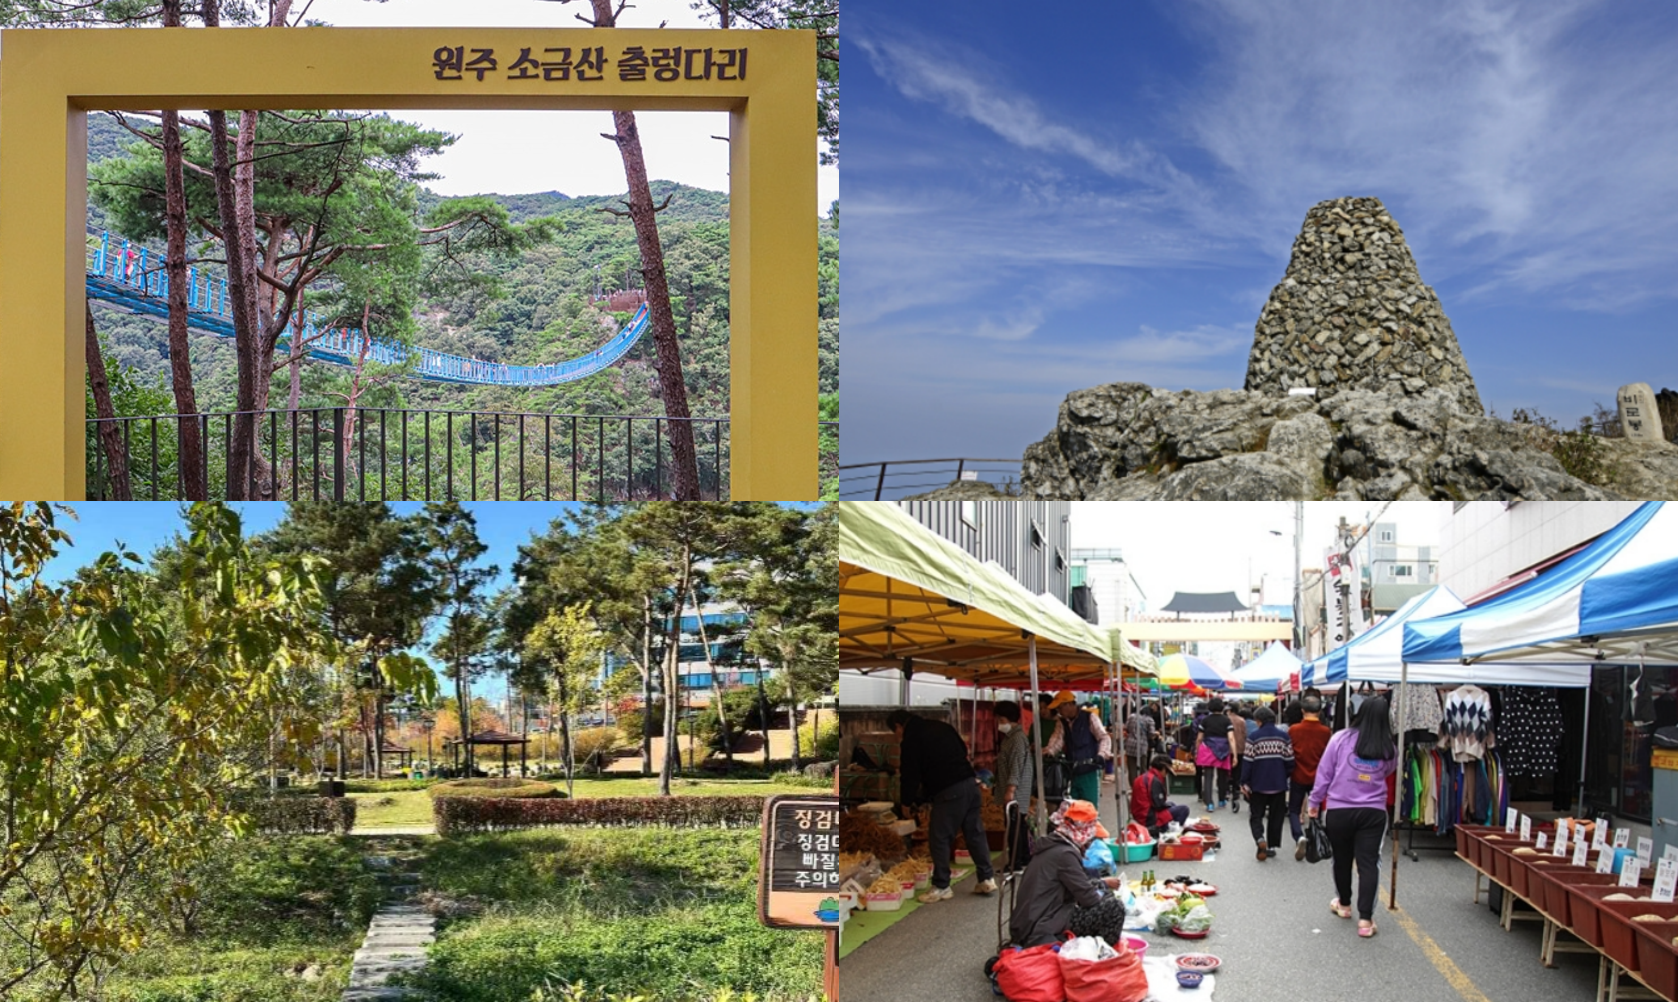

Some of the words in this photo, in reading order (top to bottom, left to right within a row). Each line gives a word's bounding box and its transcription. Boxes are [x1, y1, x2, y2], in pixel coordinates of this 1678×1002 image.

[432, 45, 497, 82] 원주
[507, 46, 609, 82] 소금산
[617, 46, 748, 82] 출렁다리
[795, 810, 839, 829] 징검
[803, 853, 839, 870] 빠질
